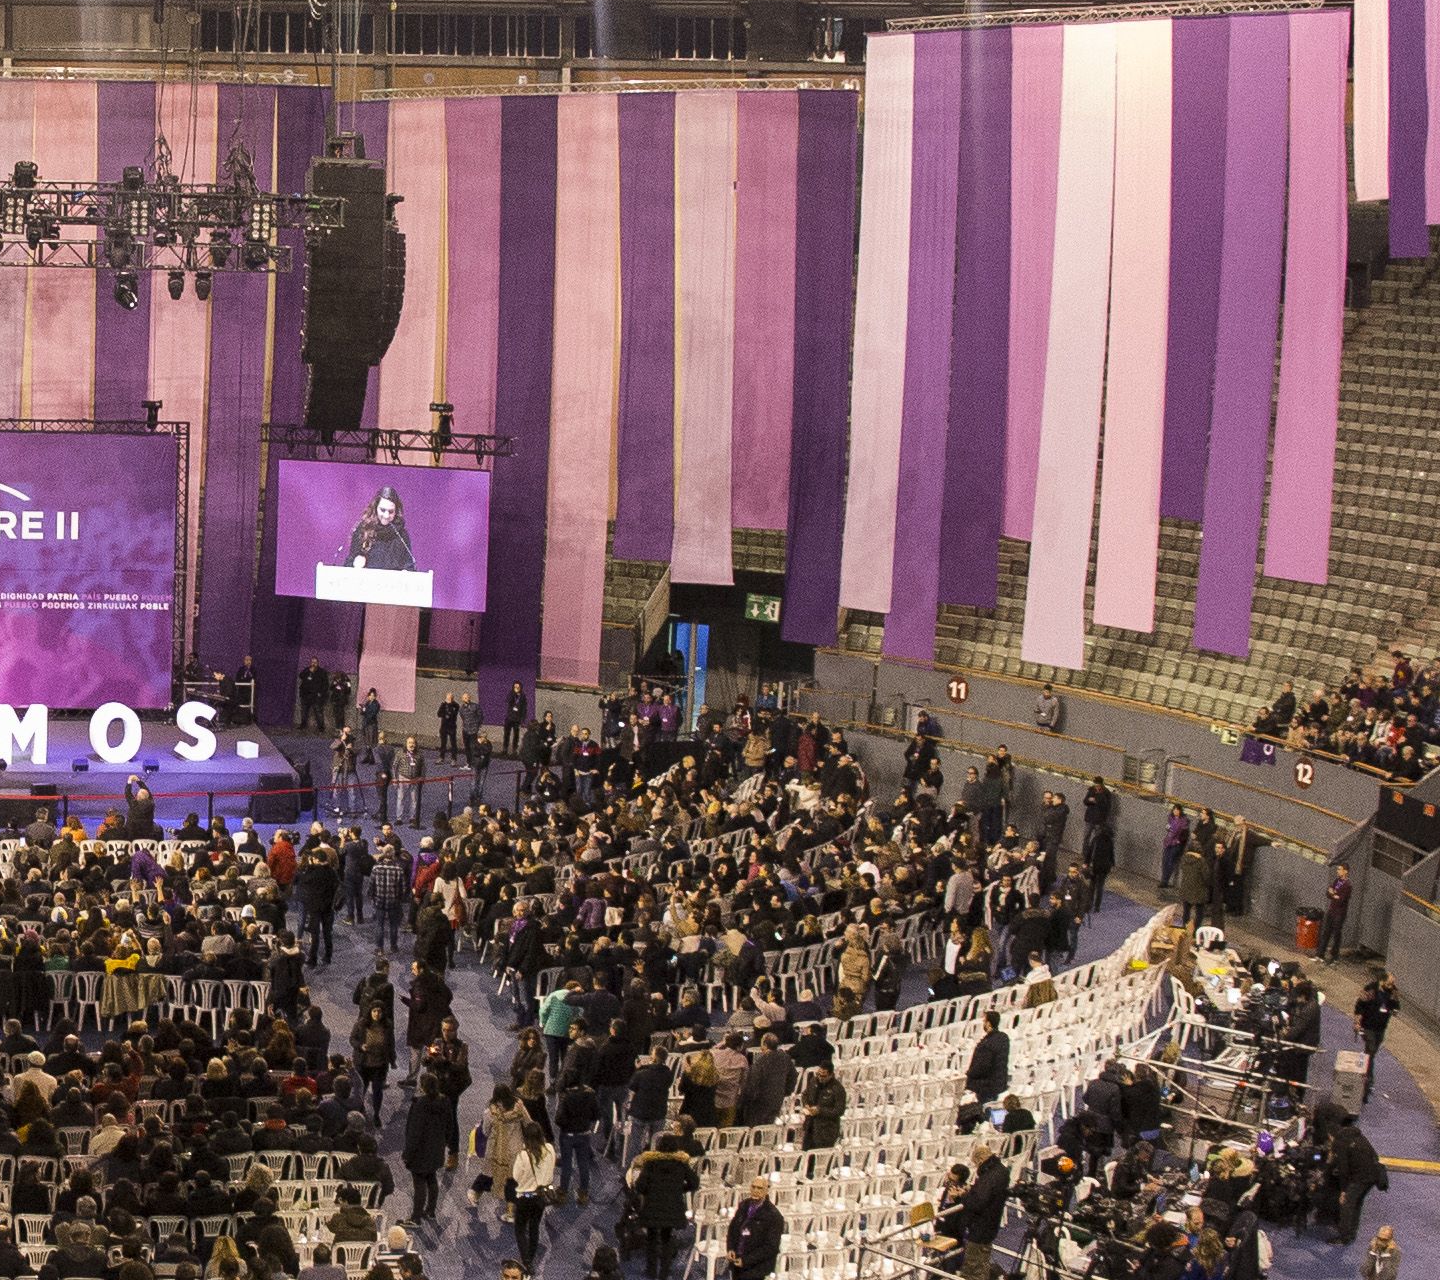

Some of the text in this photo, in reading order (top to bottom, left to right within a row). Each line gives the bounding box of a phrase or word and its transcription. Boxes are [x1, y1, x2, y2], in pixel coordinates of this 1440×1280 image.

[55, 511, 79, 540] II
[0, 592, 44, 600] DIGNIDAD
[104, 593, 139, 601] PUEBLO
[42, 601, 85, 609] PODEMOS
[88, 602, 138, 610] ZIRKULUAK
[140, 602, 169, 610] POBLE
[949, 681, 966, 699] 11
[1296, 763, 1312, 784] 12
